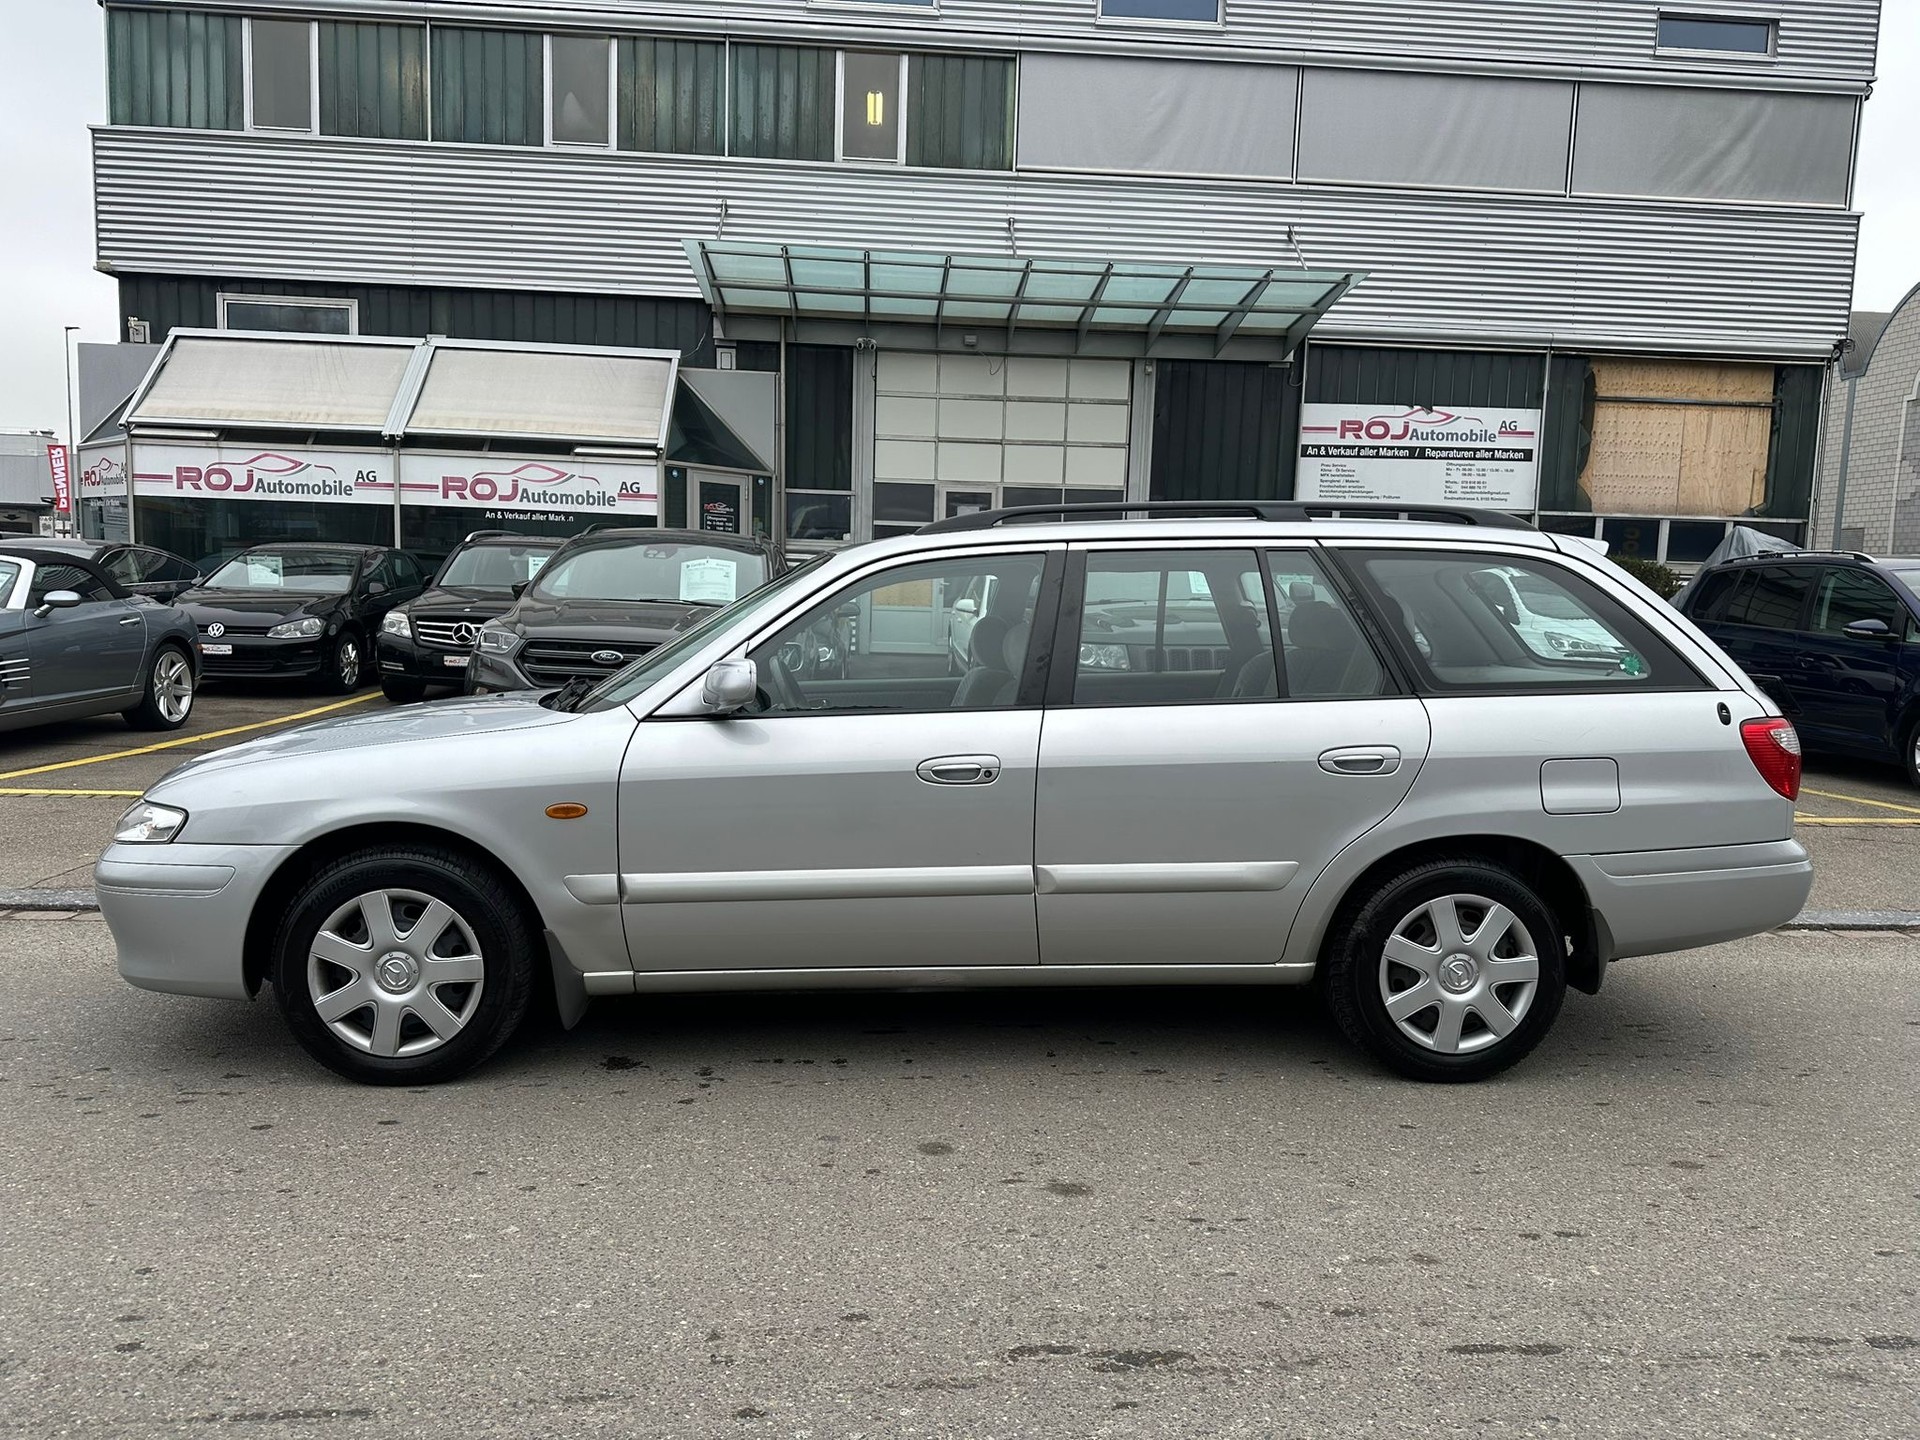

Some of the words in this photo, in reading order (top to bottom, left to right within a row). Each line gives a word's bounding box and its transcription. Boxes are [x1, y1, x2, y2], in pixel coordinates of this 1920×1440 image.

[1339, 419, 1410, 441] ROJ
[1409, 428, 1497, 443] Automobile
[1499, 420, 1518, 431] AG
[1306, 446, 1318, 455] An
[1320, 446, 1326, 456] &
[1328, 446, 1358, 457] Verkauf
[1359, 447, 1377, 457] aller
[1379, 447, 1409, 458] Marken
[1415, 448, 1420, 457] /
[1425, 448, 1474, 460] Reparaturen
[1476, 449, 1493, 459] aller
[1494, 450, 1524, 460] Marken
[84, 470, 101, 486] ROJ
[176, 466, 254, 492] ROJ
[254, 477, 353, 496] Automobile
[355, 470, 377, 483] AG
[442, 475, 519, 502] ROJ
[519, 487, 616, 507] Automobile
[619, 481, 641, 493] AG
[485, 511, 496, 519] An
[497, 511, 503, 519] &
[504, 511, 531, 520] Verkauf
[532, 512, 547, 521] aller
[548, 513, 574, 522] Markn
